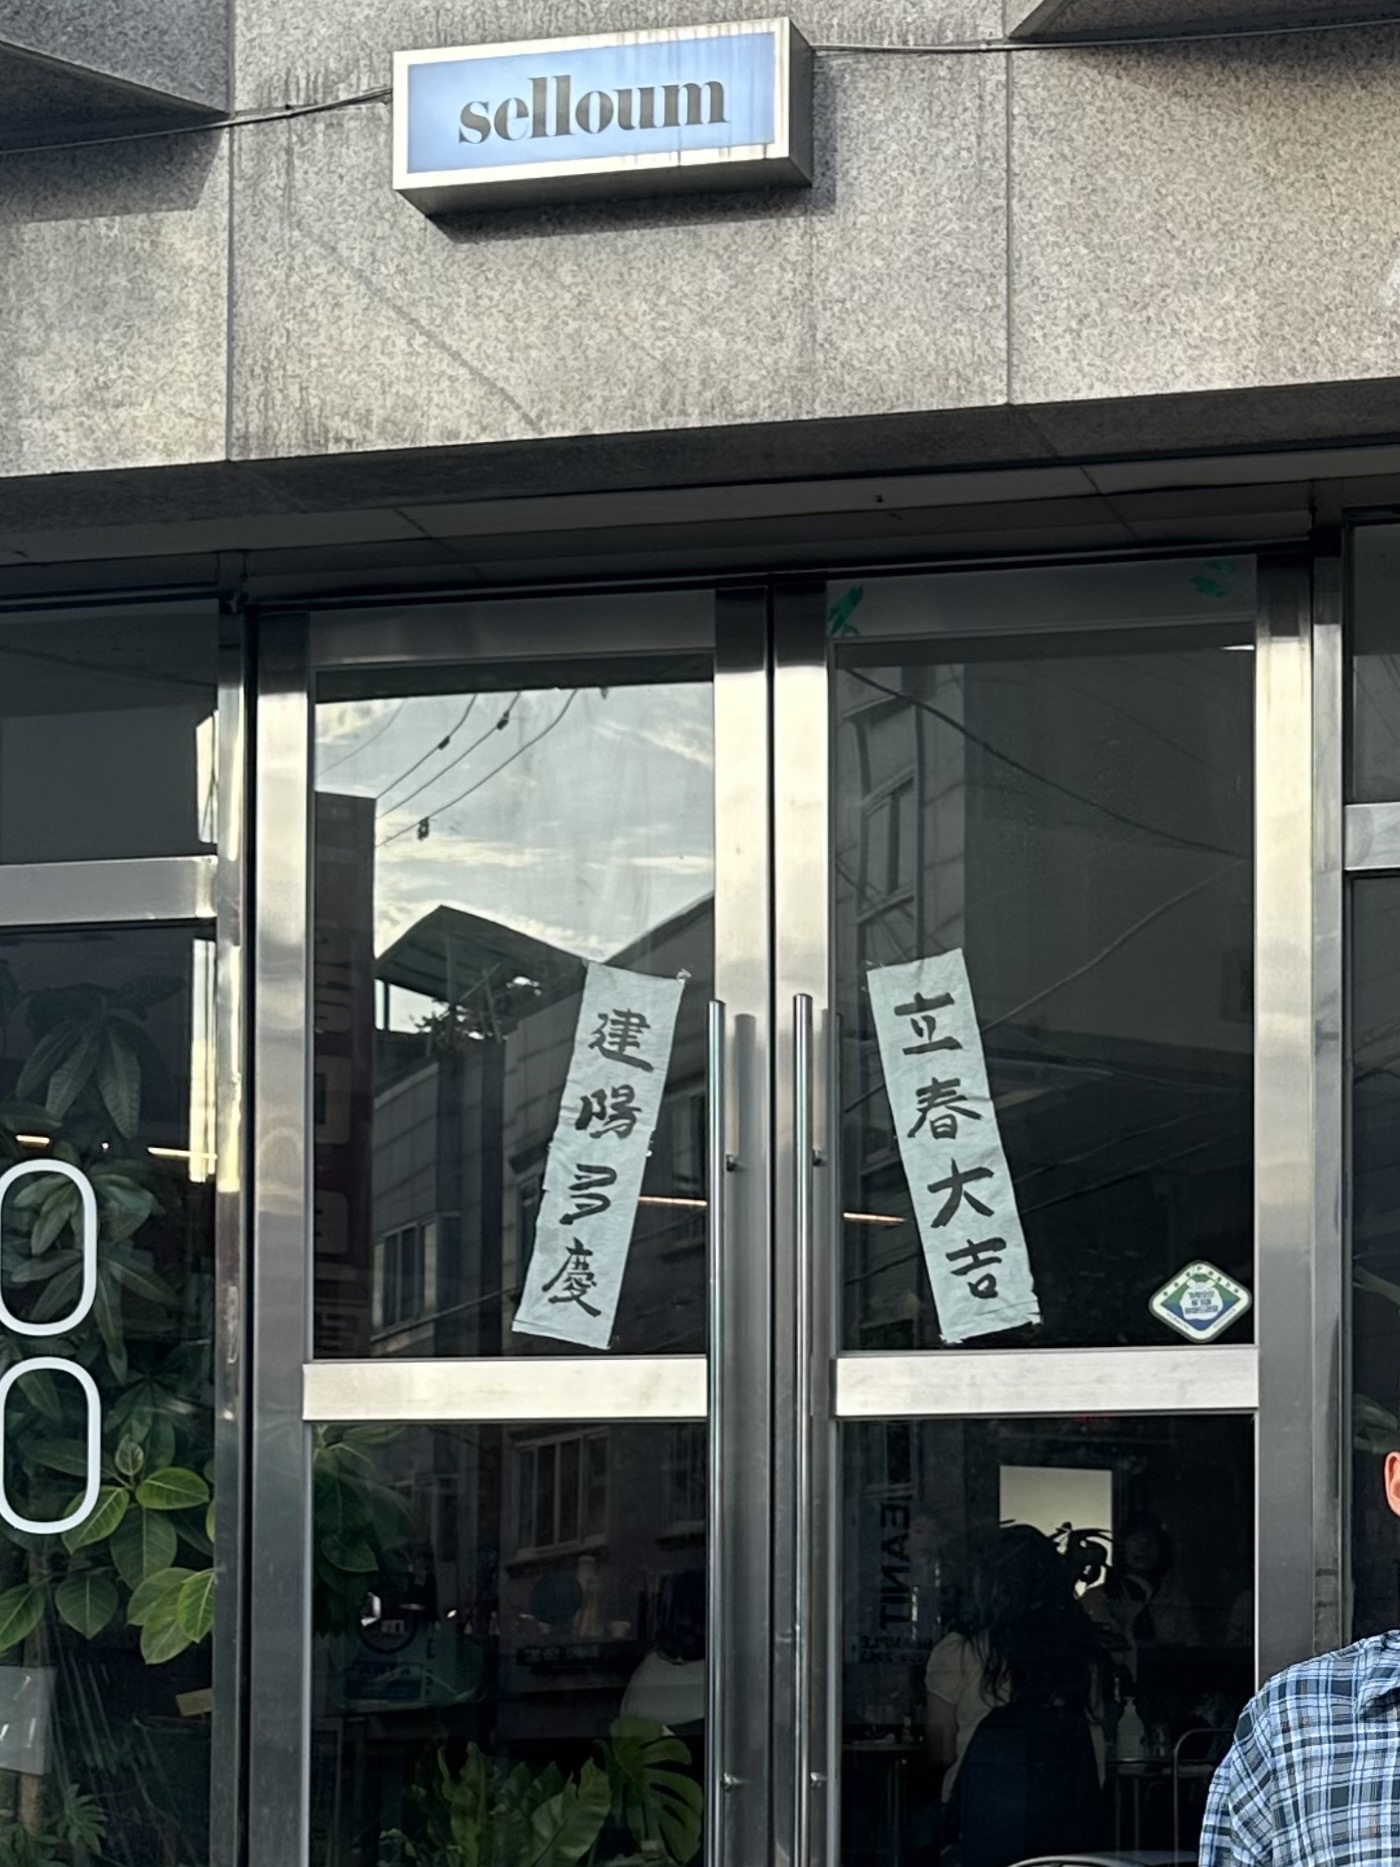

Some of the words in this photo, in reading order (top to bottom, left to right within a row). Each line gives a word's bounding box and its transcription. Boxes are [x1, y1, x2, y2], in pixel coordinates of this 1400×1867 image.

[458, 74, 730, 145] selloum
[894, 991, 1007, 1300] 立春大吉
